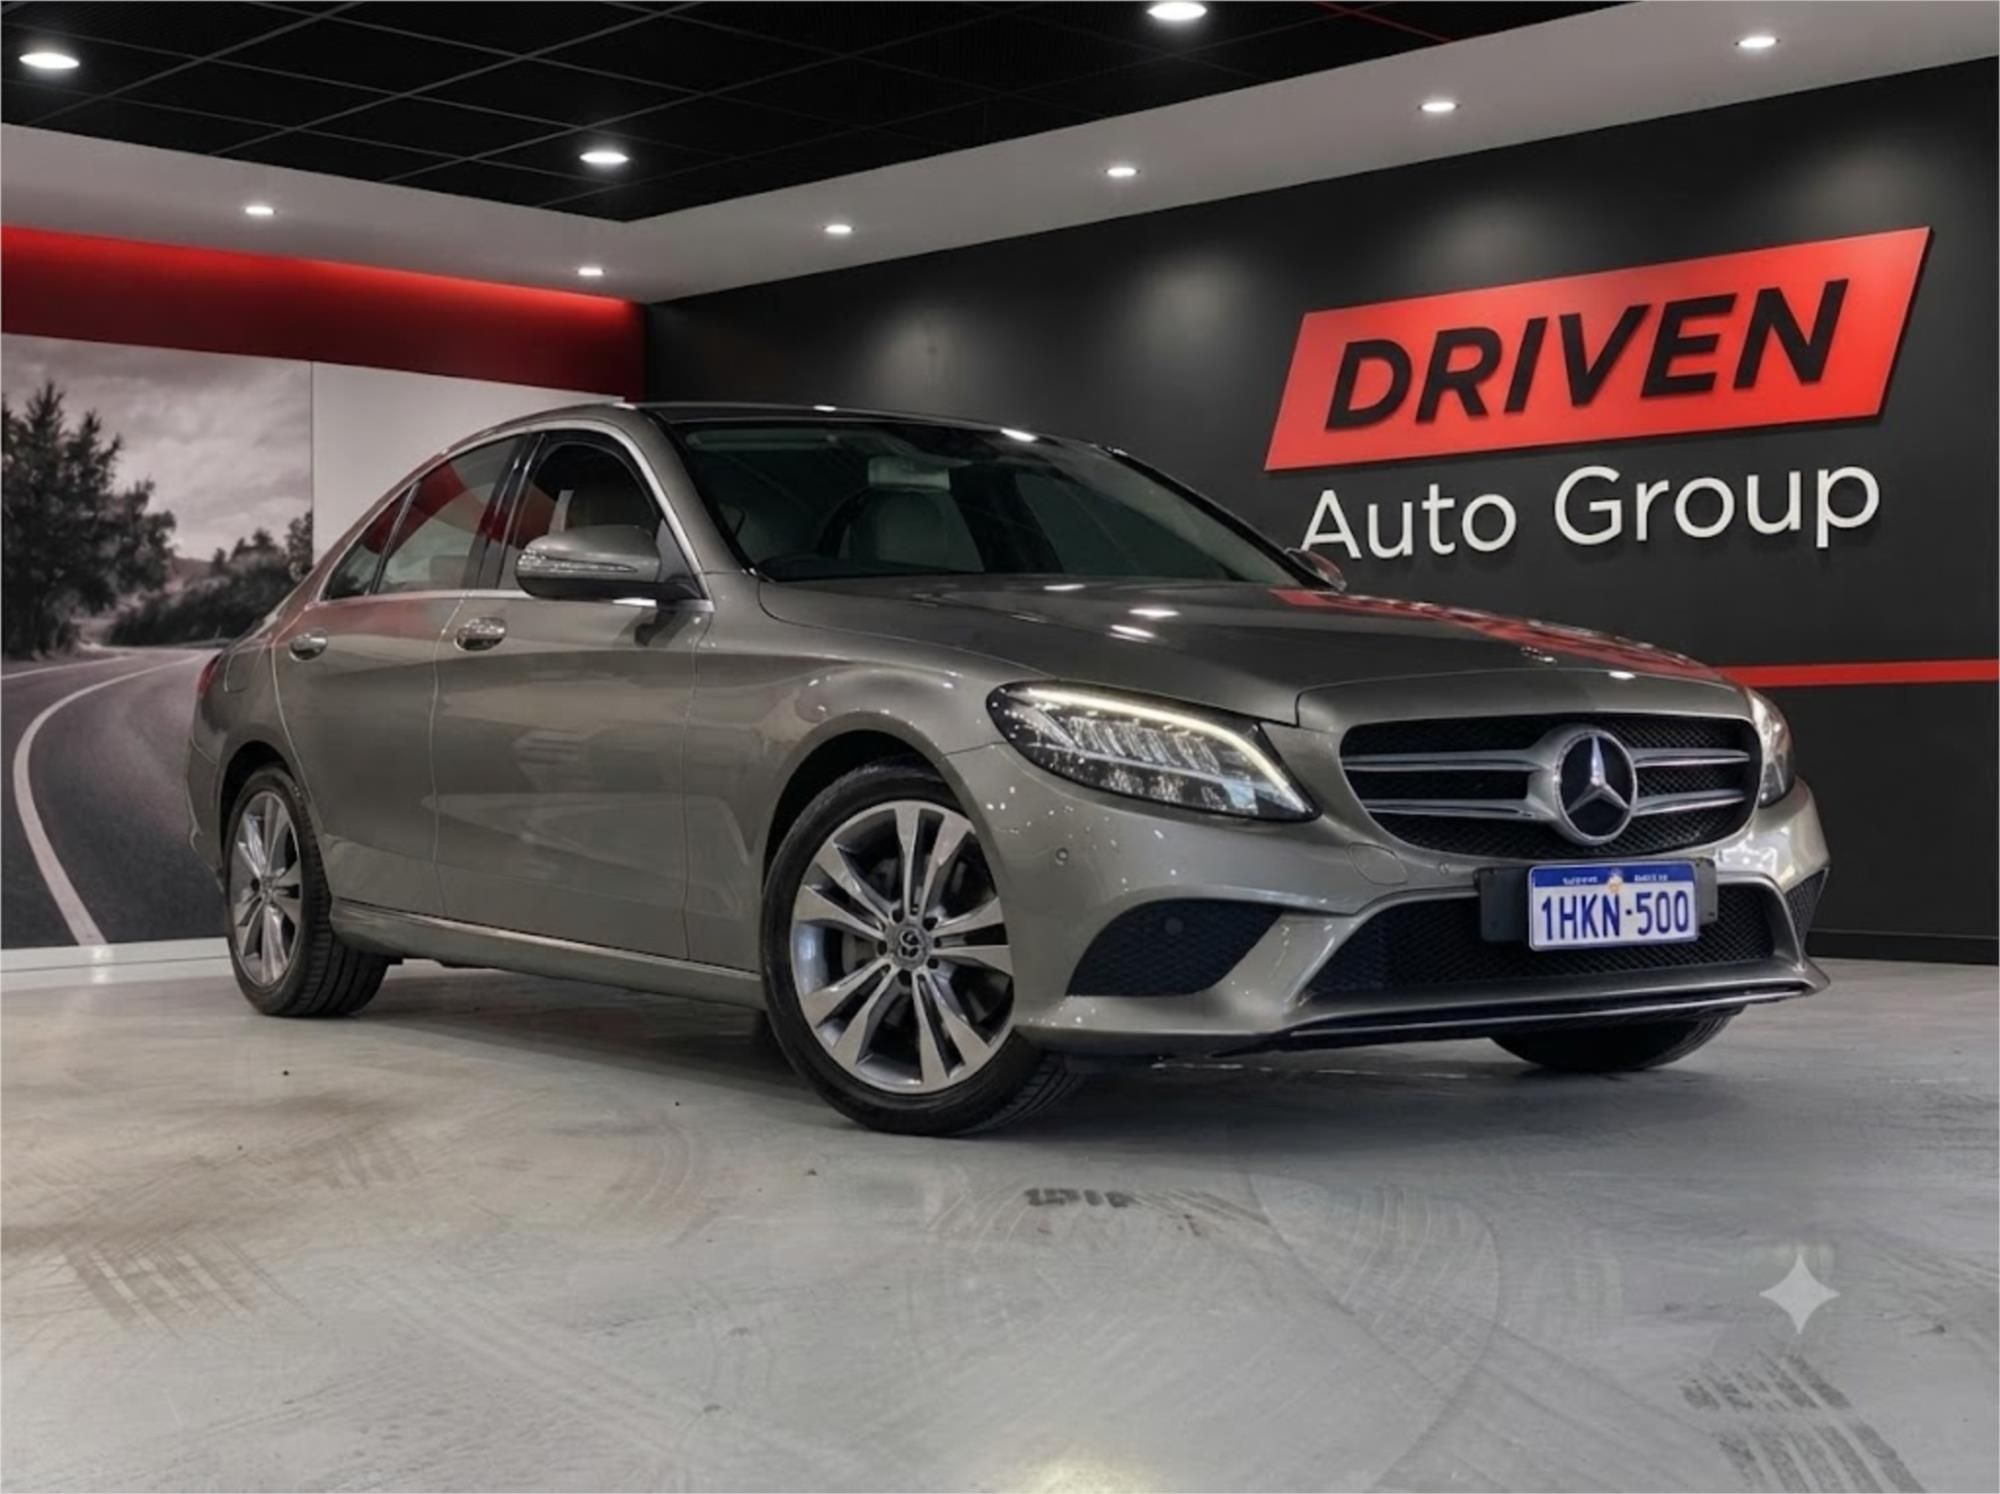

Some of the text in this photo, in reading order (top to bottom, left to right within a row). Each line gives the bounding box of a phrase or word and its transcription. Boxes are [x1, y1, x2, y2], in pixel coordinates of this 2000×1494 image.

[1325, 279, 1849, 430] DRIVEN
[1301, 463, 1881, 559] Auto Group
